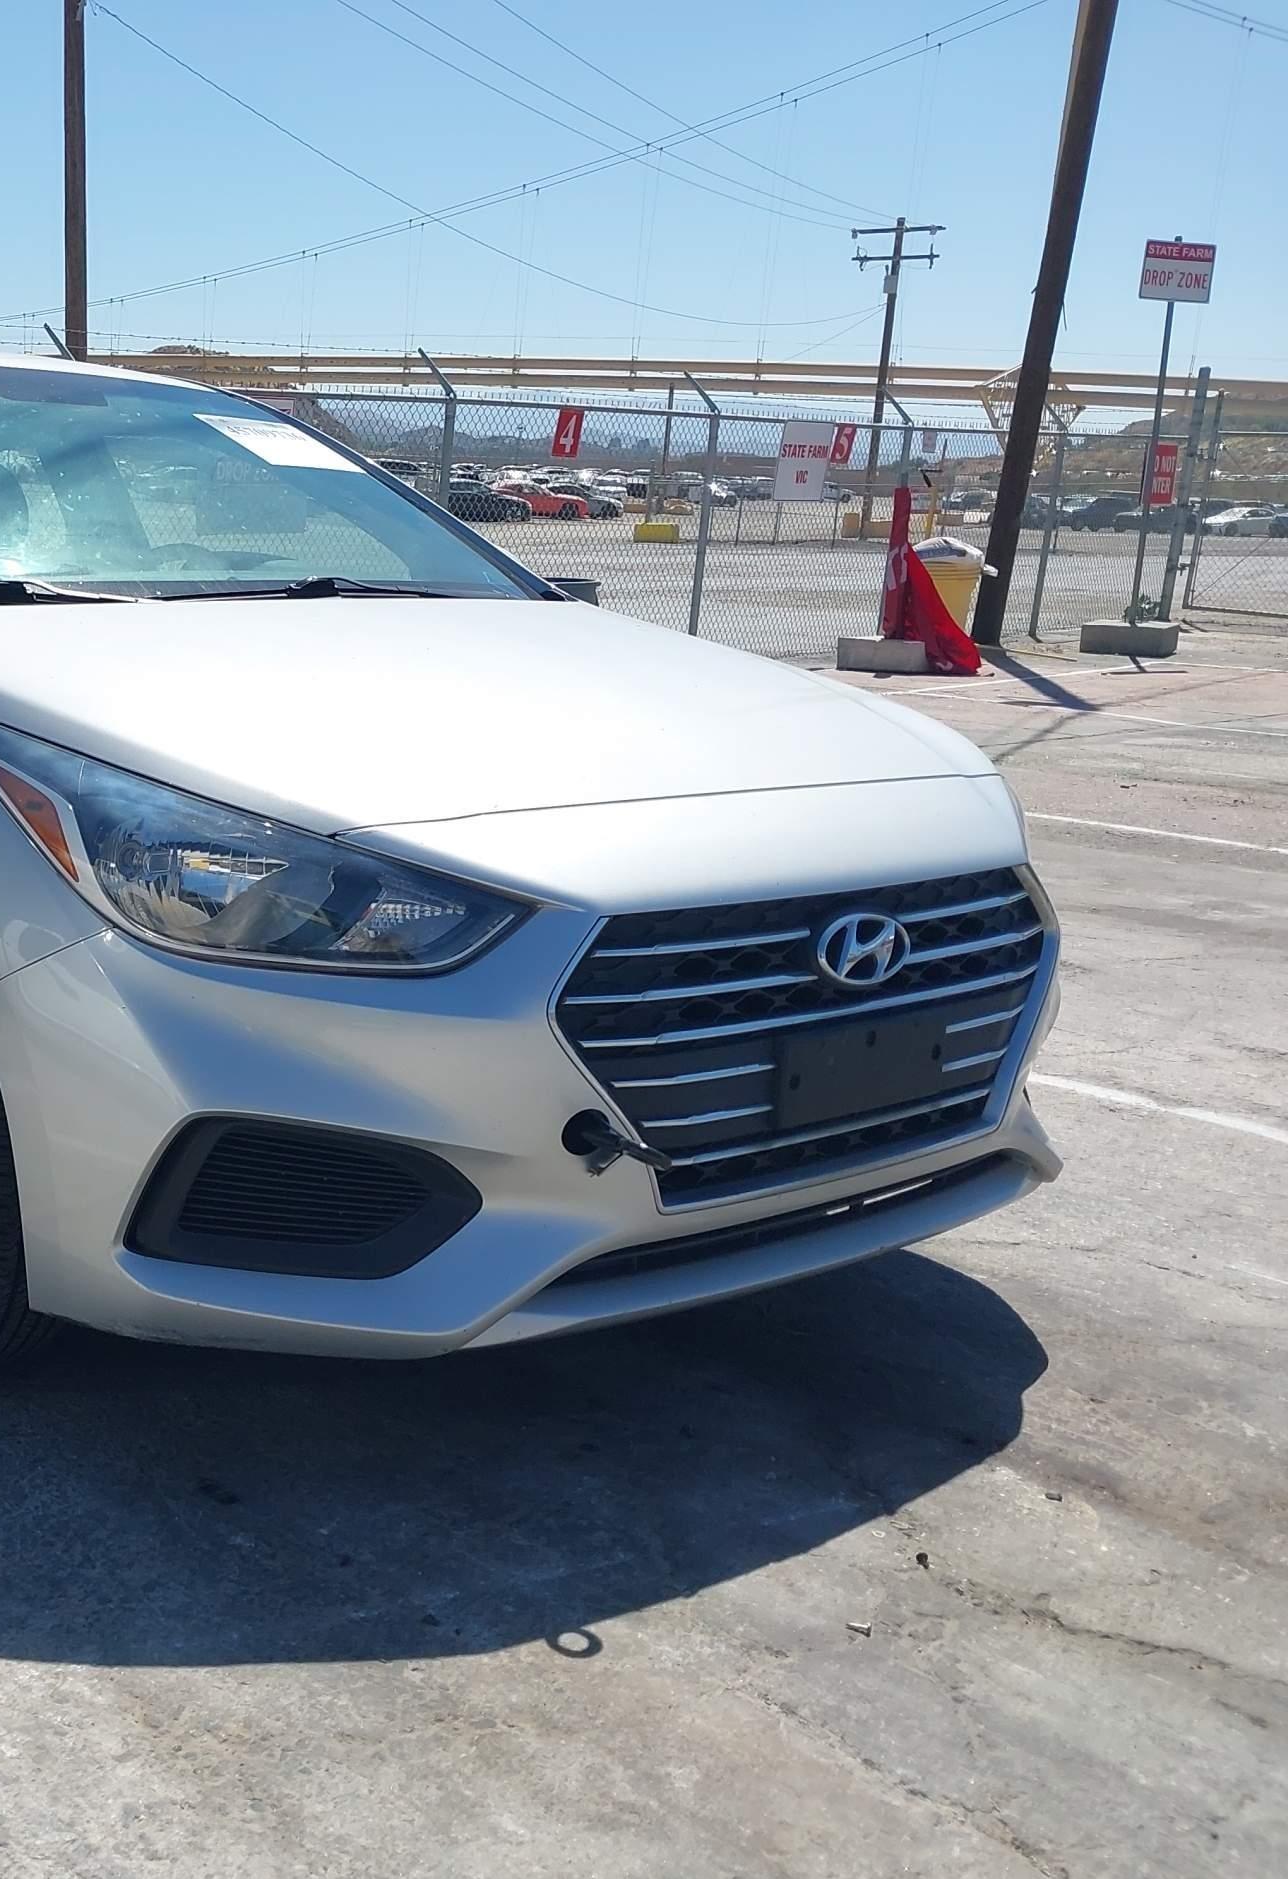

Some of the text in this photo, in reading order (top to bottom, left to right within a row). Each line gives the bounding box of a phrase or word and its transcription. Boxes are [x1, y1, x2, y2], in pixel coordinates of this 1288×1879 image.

[1148, 244, 1213, 259] STATE FARM
[1144, 268, 1209, 289] DROP ZONE
[559, 415, 577, 453] 4
[835, 427, 853, 460] 5
[781, 444, 829, 459] STATE FARM
[216, 461, 251, 481] DROP
[1161, 456, 1176, 473] NOT
[795, 470, 809, 484] VIC
[1150, 477, 1171, 496] NTER
